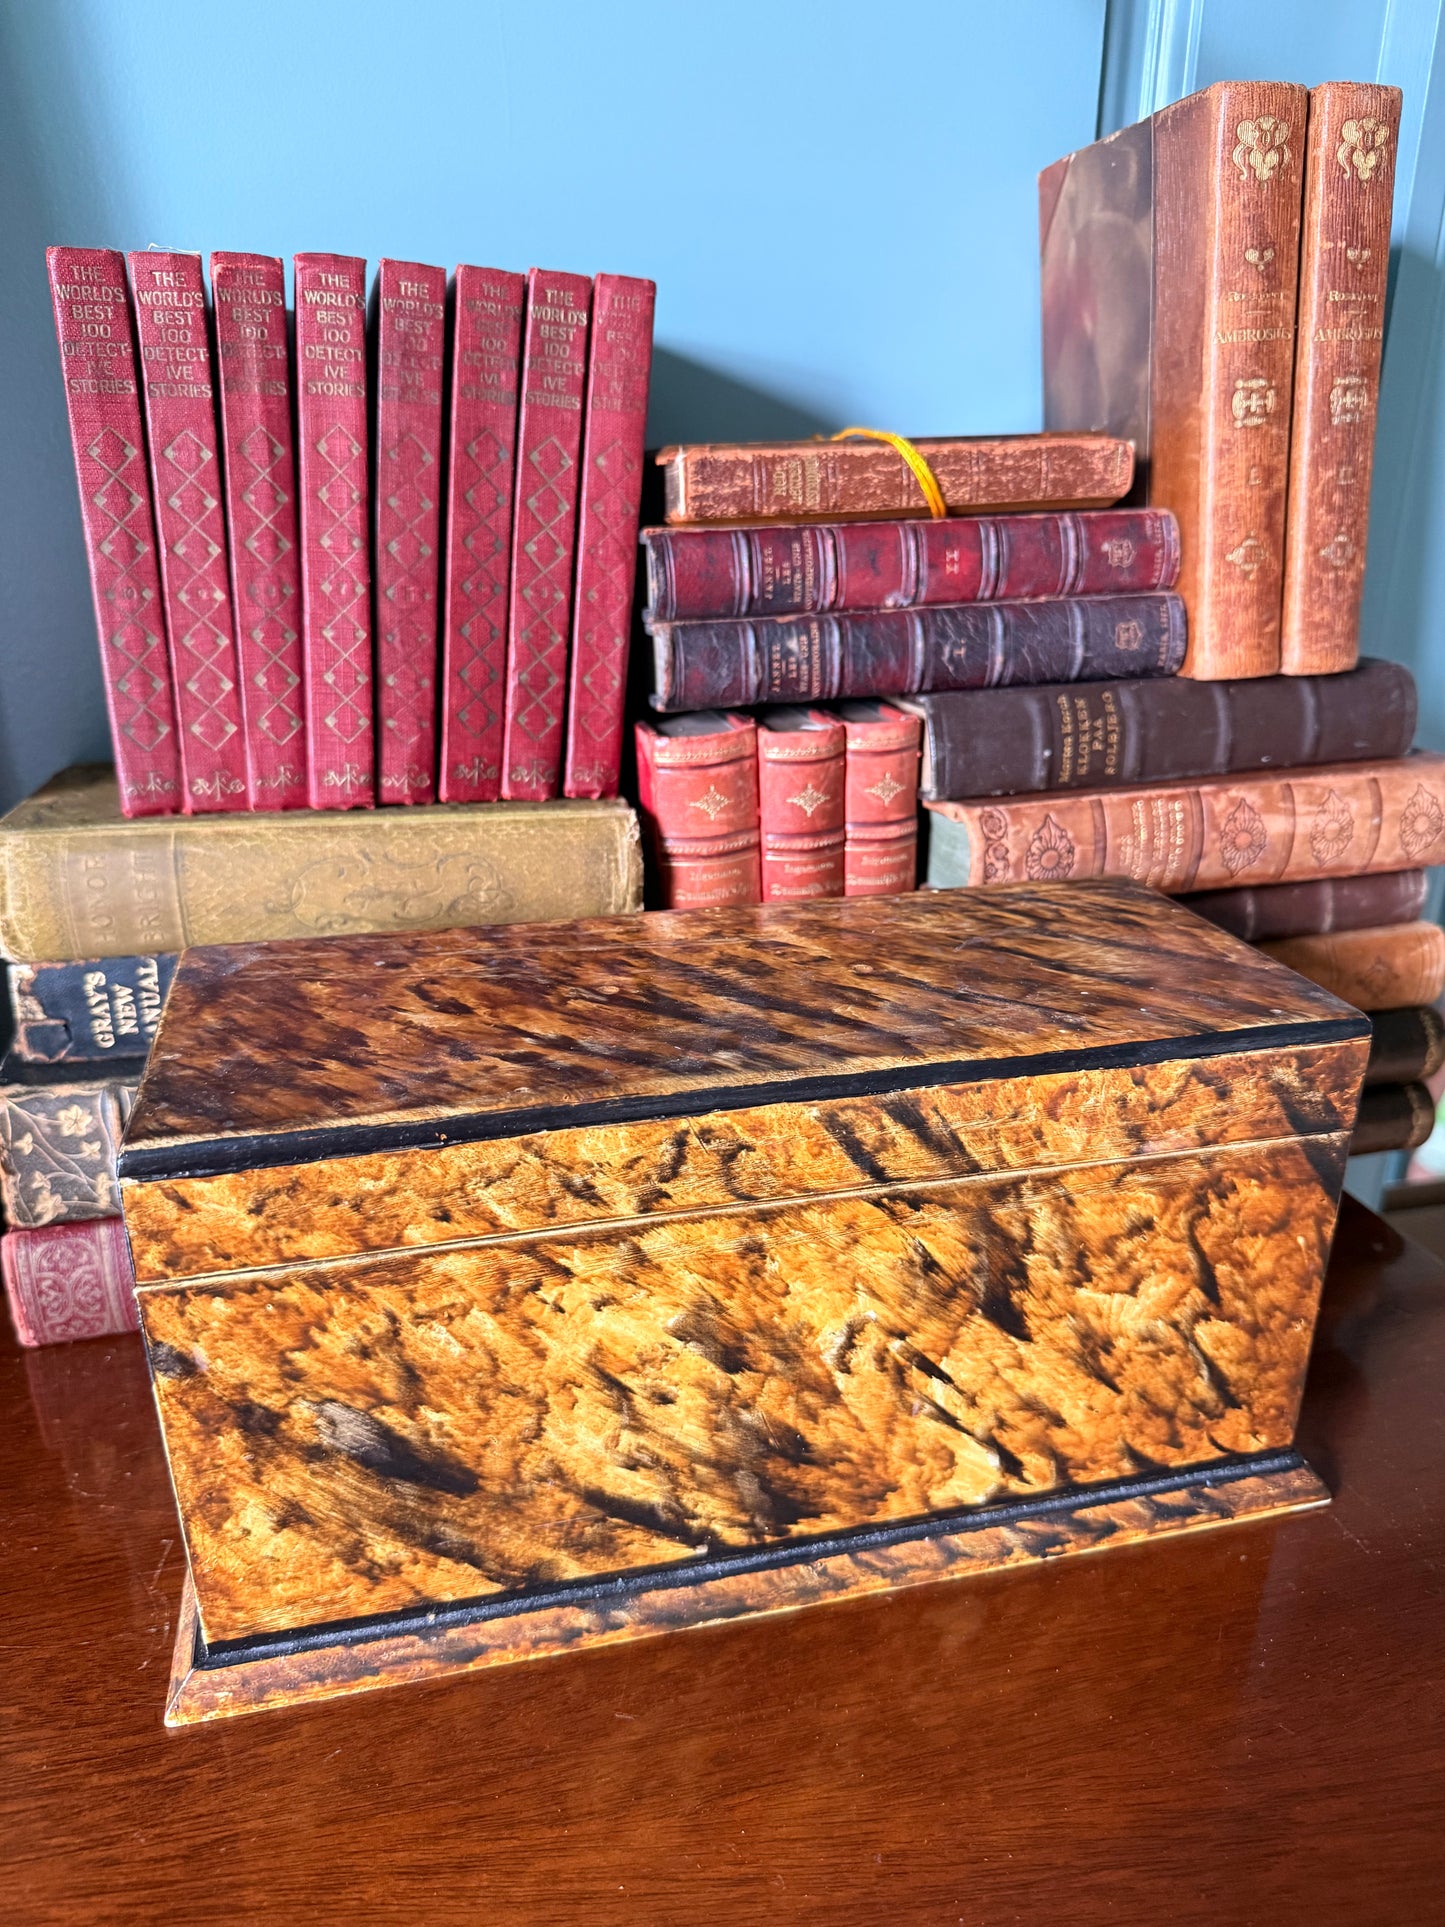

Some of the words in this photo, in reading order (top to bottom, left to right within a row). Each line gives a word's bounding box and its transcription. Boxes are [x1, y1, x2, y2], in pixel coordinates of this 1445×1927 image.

[70, 266, 106, 282] THE
[152, 271, 186, 287] THE
[234, 272, 265, 285] THE
[318, 274, 350, 288] THE
[59, 285, 126, 302] WORLD'S
[138, 290, 204, 307] WORLD'S
[399, 282, 429, 299] THE
[482, 283, 509, 298] THE
[544, 290, 574, 307] THE
[305, 290, 366, 309] WORLD'S
[72, 305, 114, 319] BEST
[232, 310, 271, 323] BEST
[383, 298, 444, 319] WORLD'S
[531, 308, 587, 325] WORLD'S
[153, 312, 193, 325] BEST
[316, 311, 355, 325] BEST
[81, 324, 110, 338] 100
[395, 320, 432, 335] BEST
[540, 326, 576, 342] BEST
[1314, 328, 1382, 341] AMBROSIUS
[161, 329, 190, 343] 100
[323, 330, 350, 343] 100
[1213, 328, 1291, 344] AMBROSIUS
[63, 342, 132, 358] DETECT-
[480, 338, 506, 352] 100
[544, 344, 569, 358] 100
[144, 347, 210, 361] DETECT-
[166, 366, 193, 380] IVE
[324, 365, 349, 378] IVE
[70, 379, 135, 394] STORIES
[149, 384, 212, 398] STORIES
[307, 383, 366, 398] STORIES
[542, 376, 566, 391] IVE
[525, 393, 580, 411] STORIES
[945, 549, 960, 575] II
[764, 547, 774, 599] JANNET
[782, 561, 792, 585] LES
[771, 644, 781, 692] JANNET
[788, 657, 797, 678] LES
[1075, 697, 1090, 775] KLOKKEN
[1092, 718, 1104, 750] PAA
[135, 957, 162, 1043] ANUAL
[83, 970, 116, 1048] GRAY'S
[110, 983, 139, 1036] NEW
